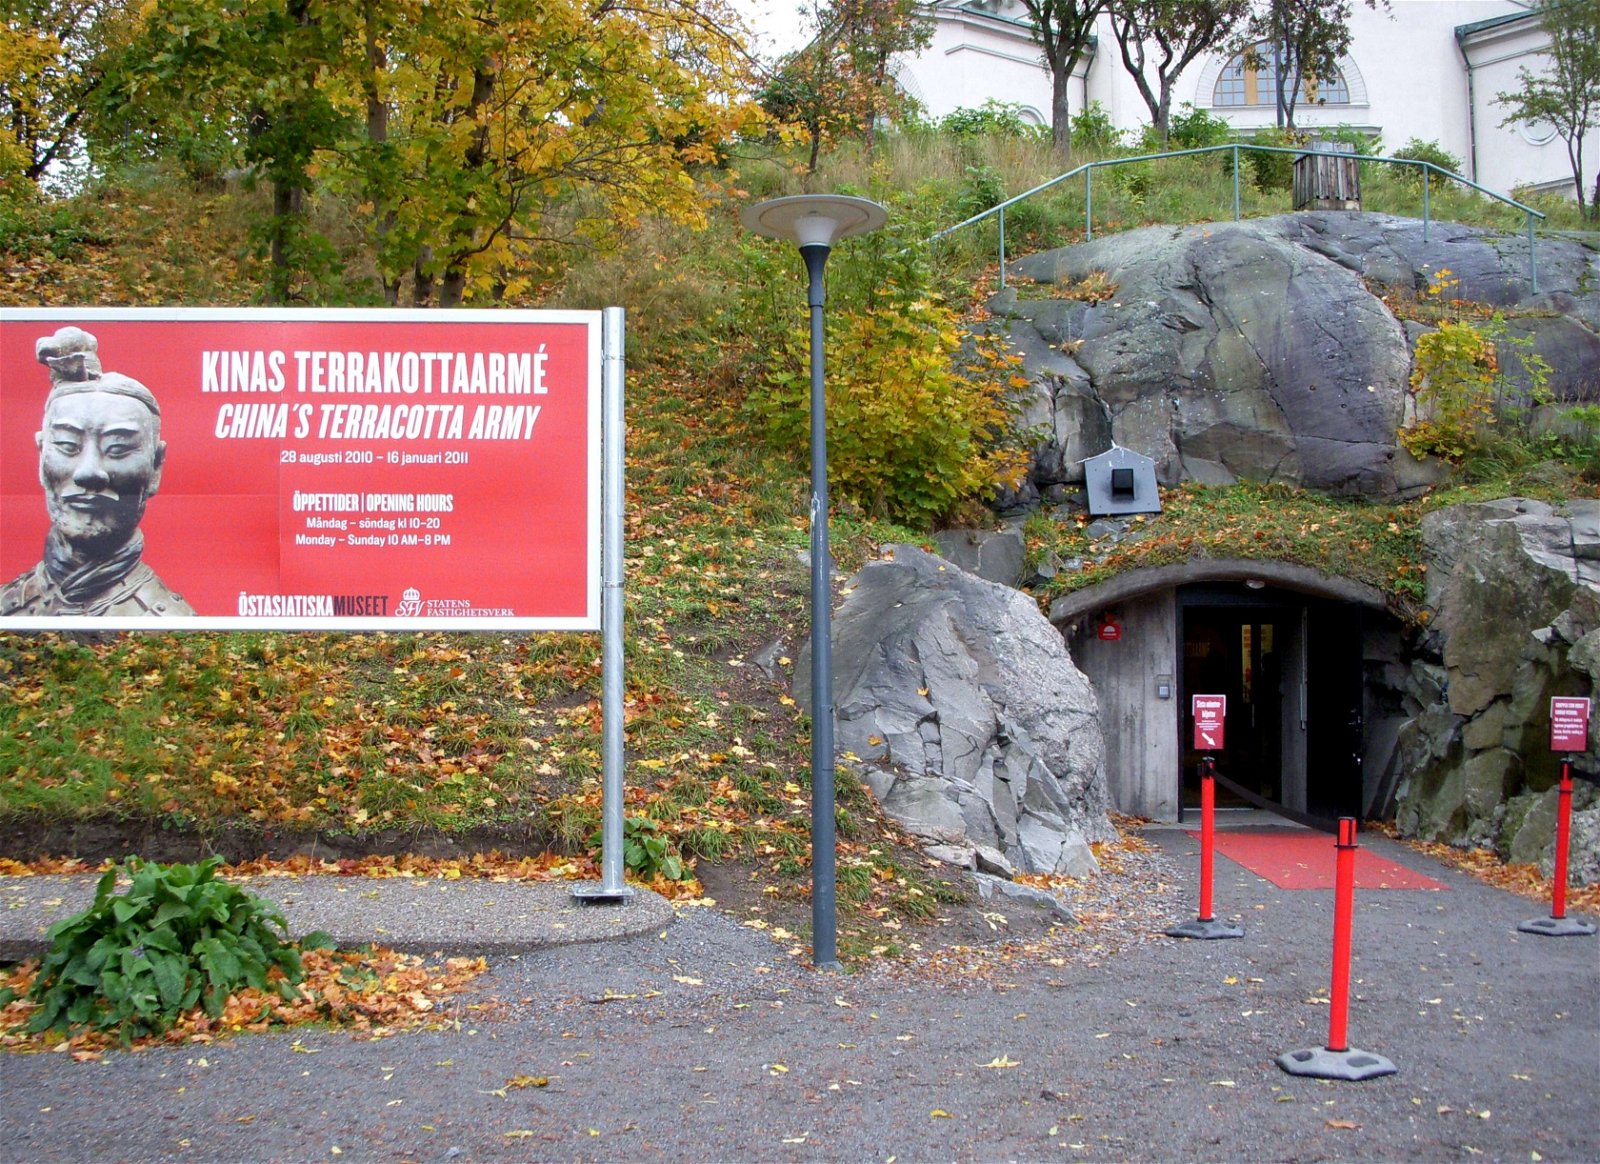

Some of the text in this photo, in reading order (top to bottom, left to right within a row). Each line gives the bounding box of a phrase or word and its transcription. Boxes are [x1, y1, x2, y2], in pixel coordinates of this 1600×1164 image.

[201, 343, 549, 395] KINAS TERRAKOTTAARMÉ
[318, 402, 464, 440] TERRACOTTA
[467, 404, 542, 440] ARMY
[280, 449, 297, 464] 28
[299, 450, 343, 466] augusti
[344, 450, 374, 464] 2010
[386, 450, 400, 464] 16
[401, 450, 442, 466] januari
[444, 451, 469, 464] 2011
[292, 490, 360, 513] ÖPPETTIDER
[366, 493, 415, 512] OPENING
[416, 494, 454, 512] HOURS
[306, 516, 348, 531] Måndag
[358, 517, 396, 531] söndag
[397, 517, 407, 529] kl
[295, 533, 336, 548] Monday
[347, 533, 386, 548] Sunday
[387, 533, 399, 546] 10
[433, 533, 451, 546] PM
[238, 591, 389, 617] ÖSTASIATISKAMUSEET
[426, 599, 471, 610] STATENS
[426, 607, 515, 617] FASTIGHETSVERK
